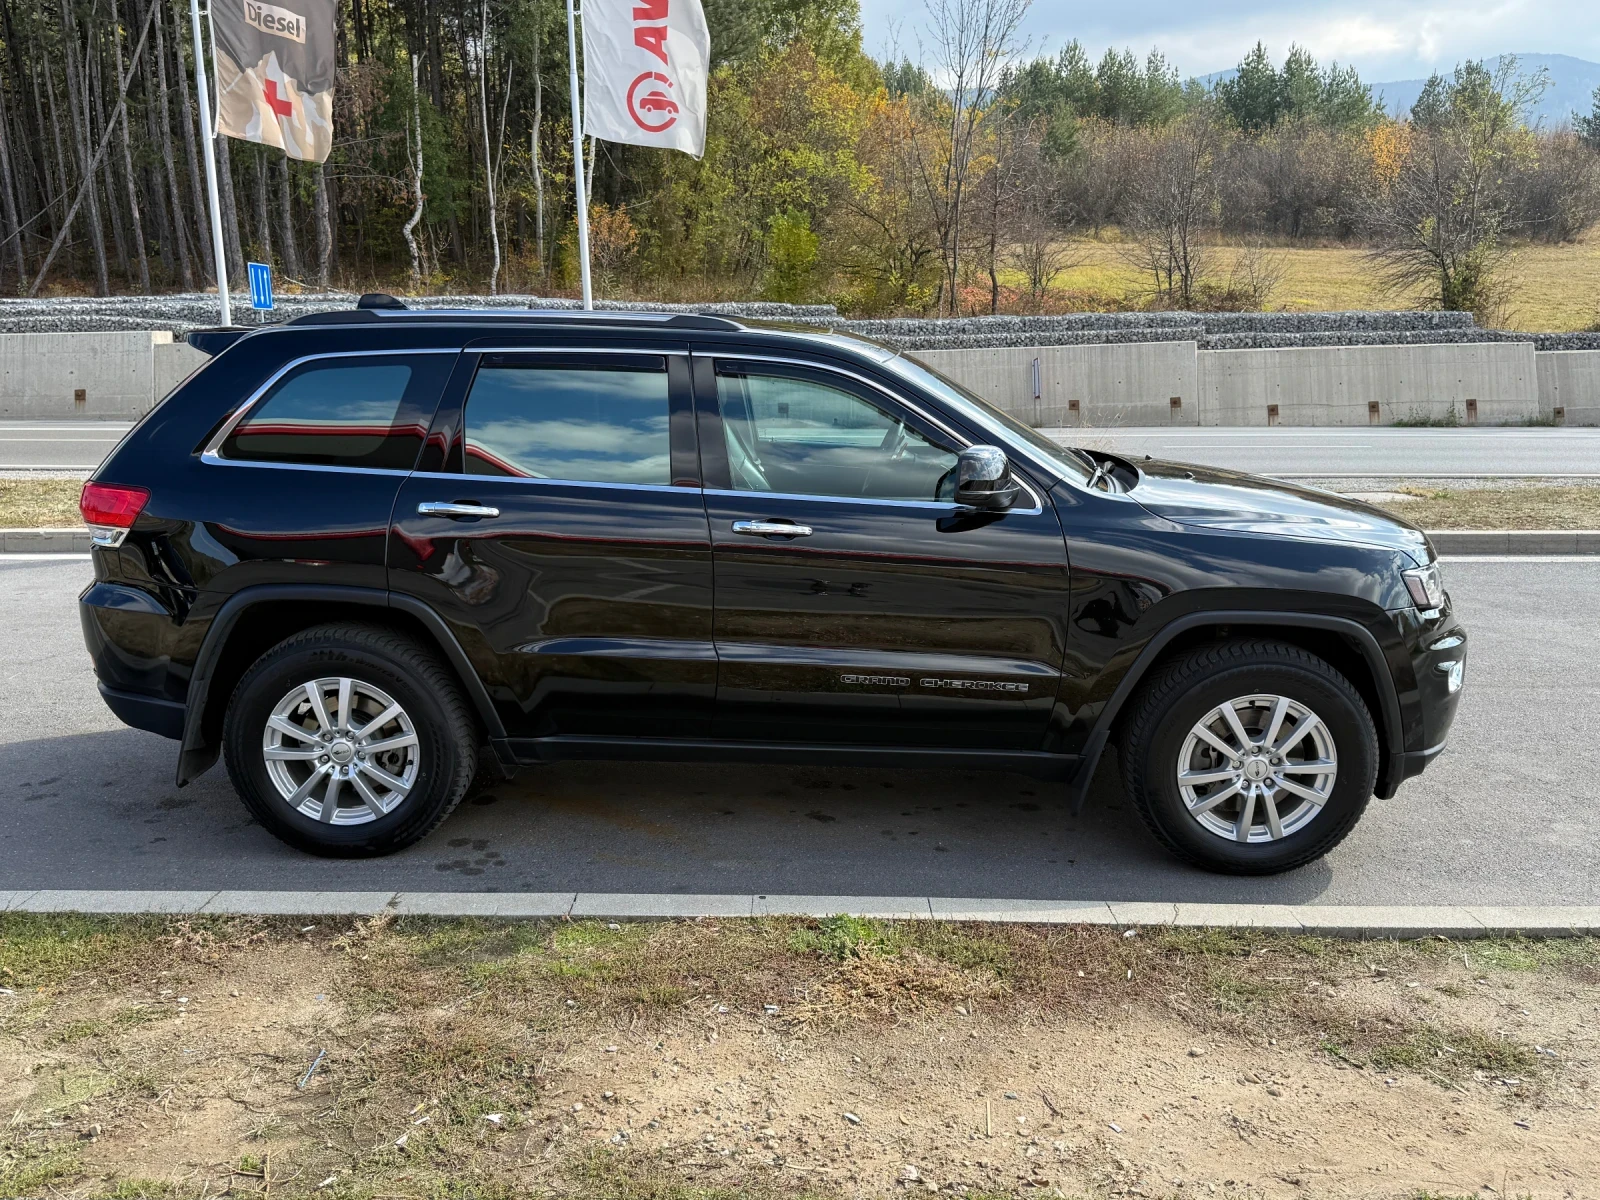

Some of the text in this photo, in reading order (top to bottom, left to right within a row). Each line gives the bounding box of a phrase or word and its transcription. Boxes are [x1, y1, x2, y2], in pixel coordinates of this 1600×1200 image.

[246, 1, 300, 38] Diesel
[840, 674, 1029, 693] GRAND CHEROKEE
